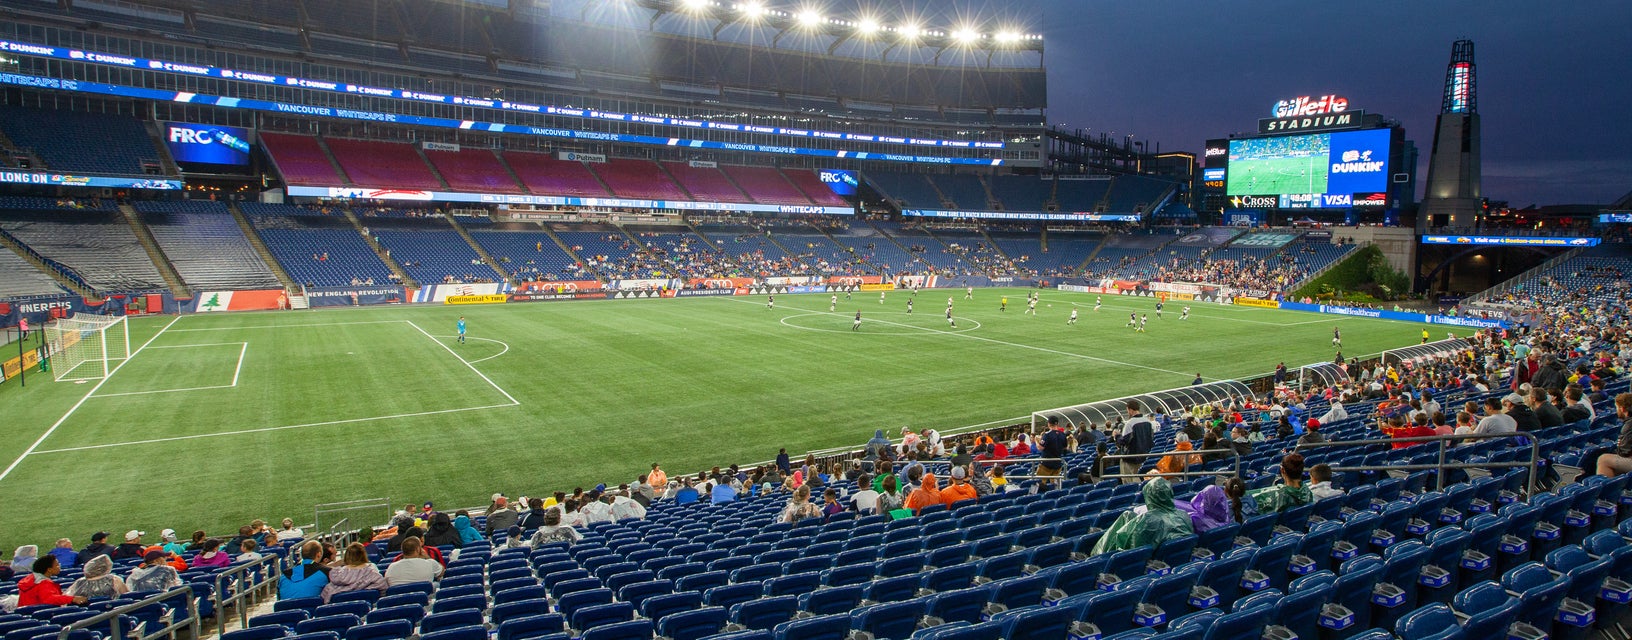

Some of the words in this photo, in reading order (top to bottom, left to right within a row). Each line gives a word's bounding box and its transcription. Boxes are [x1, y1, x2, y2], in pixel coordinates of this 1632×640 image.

[10, 43, 55, 56] DUNKIN'
[96, 54, 136, 66] DUNKIN'
[173, 64, 210, 74] DUNKIN'
[62, 80, 78, 90] FC
[1272, 95, 1348, 118] Gillette
[278, 104, 330, 116] VANCOUVER
[336, 109, 384, 121] WHITECAPS
[1268, 114, 1350, 130] STADIUM
[532, 128, 570, 137] VANCOUVER
[574, 131, 610, 140] WHITECAPS
[1205, 148, 1226, 157] jetBlue
[1332, 161, 1384, 174] DUNKIN'
[32, 174, 48, 184] ON
[1242, 195, 1276, 206] CROSS
[1323, 195, 1351, 205] VISA
[781, 205, 823, 214] WHITECAPS
[1326, 307, 1380, 317] UnitedHealthcare
[1469, 309, 1503, 318] #NEEVS
